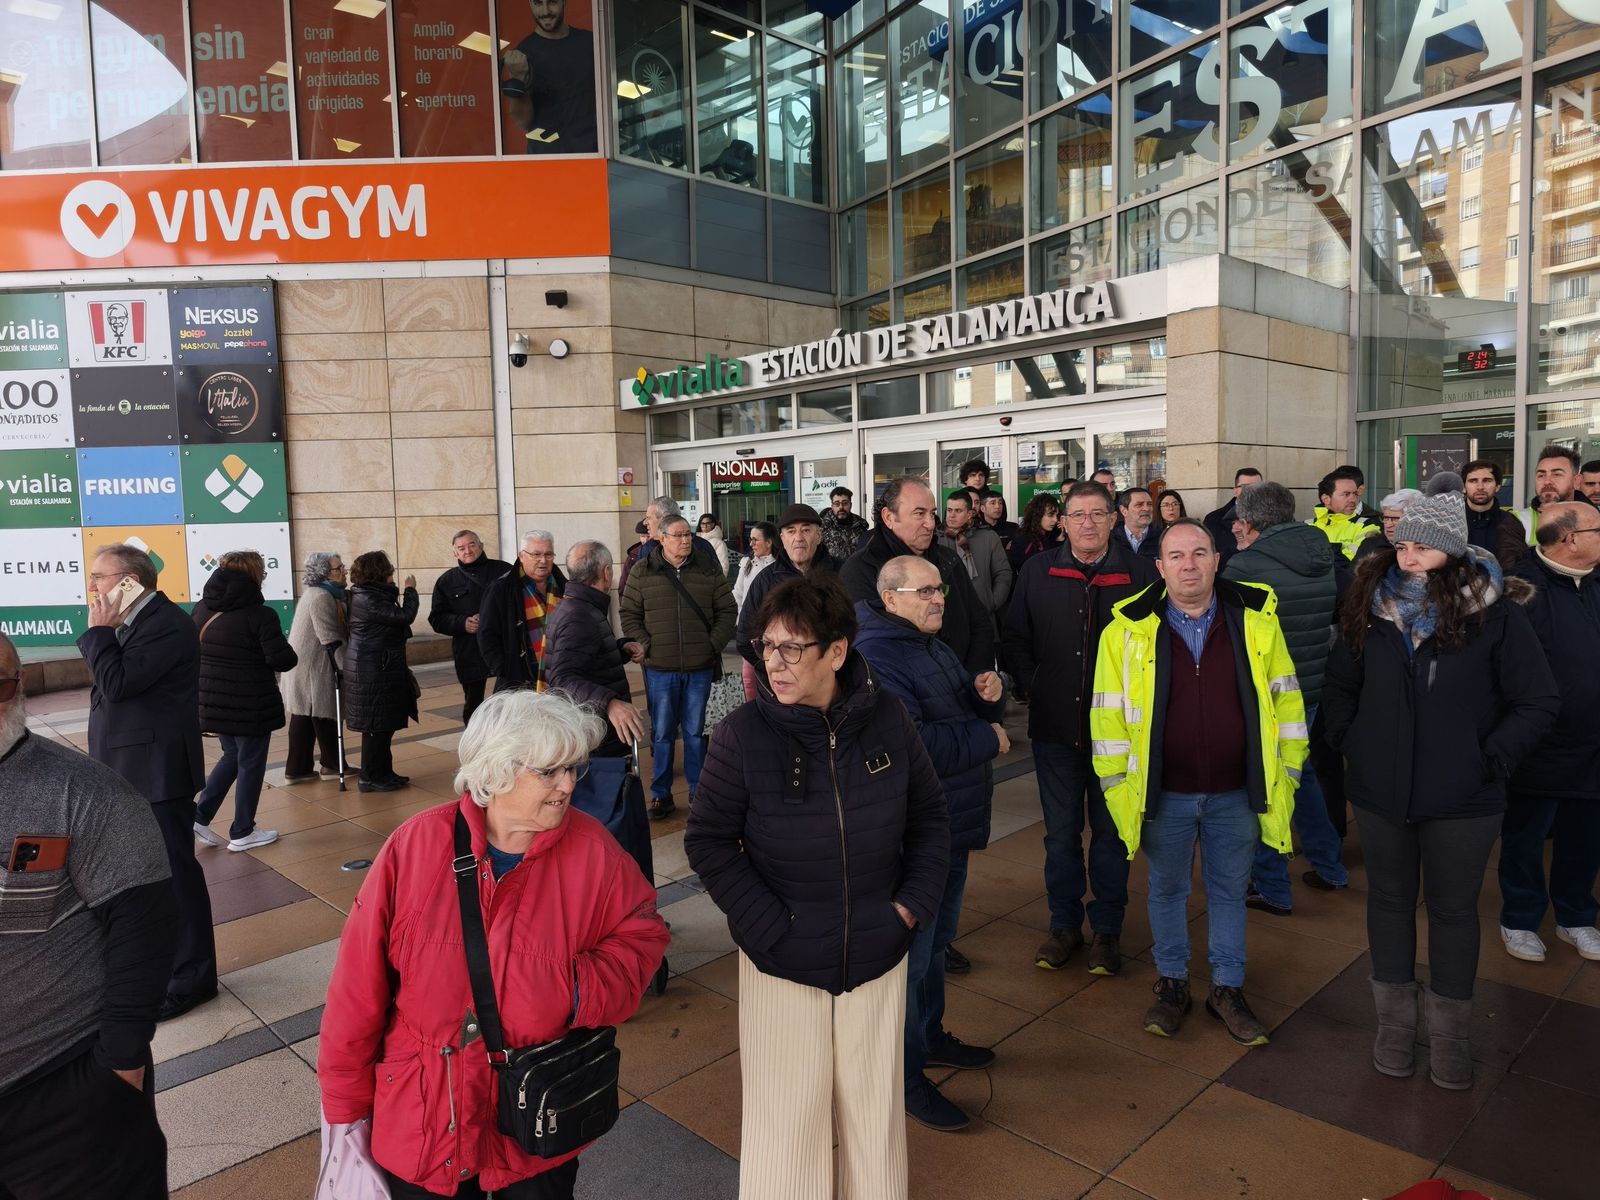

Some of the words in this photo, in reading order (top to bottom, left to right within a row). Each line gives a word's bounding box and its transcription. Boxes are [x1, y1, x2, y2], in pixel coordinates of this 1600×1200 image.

[303, 26, 334, 42] Gran
[413, 21, 456, 41] Amplio
[45, 34, 86, 68] Tu
[194, 23, 246, 61] sin
[414, 43, 463, 61] horario
[305, 47, 362, 66] variedad
[364, 46, 380, 62] de
[306, 69, 380, 88] actividades
[416, 69, 431, 85] de
[307, 92, 364, 112] dirigidas
[417, 91, 476, 111] apertura
[147, 182, 428, 244] VIVAGYM
[184, 306, 258, 325] NEKSUS
[223, 328, 253, 337] Jazztel
[658, 350, 745, 401] vialia
[758, 327, 862, 383] ESTACIÓN
[872, 325, 914, 363] DE
[915, 280, 1118, 355] SALAMANCA
[22, 344, 29, 352] DE
[29, 343, 59, 352] SALAMANCA
[102, 345, 138, 360] KFC
[224, 339, 268, 348] pepephone
[79, 405, 86, 413] la
[87, 404, 106, 414] fonda
[107, 404, 116, 412] de
[134, 403, 142, 411] la
[207, 386, 249, 414] Vitalia
[7, 473, 72, 494] vialia
[85, 476, 176, 496] FRIKING
[10, 497, 33, 507] ESTACIÓN
[34, 497, 41, 505] DE
[42, 496, 72, 506] SALAMANCA
